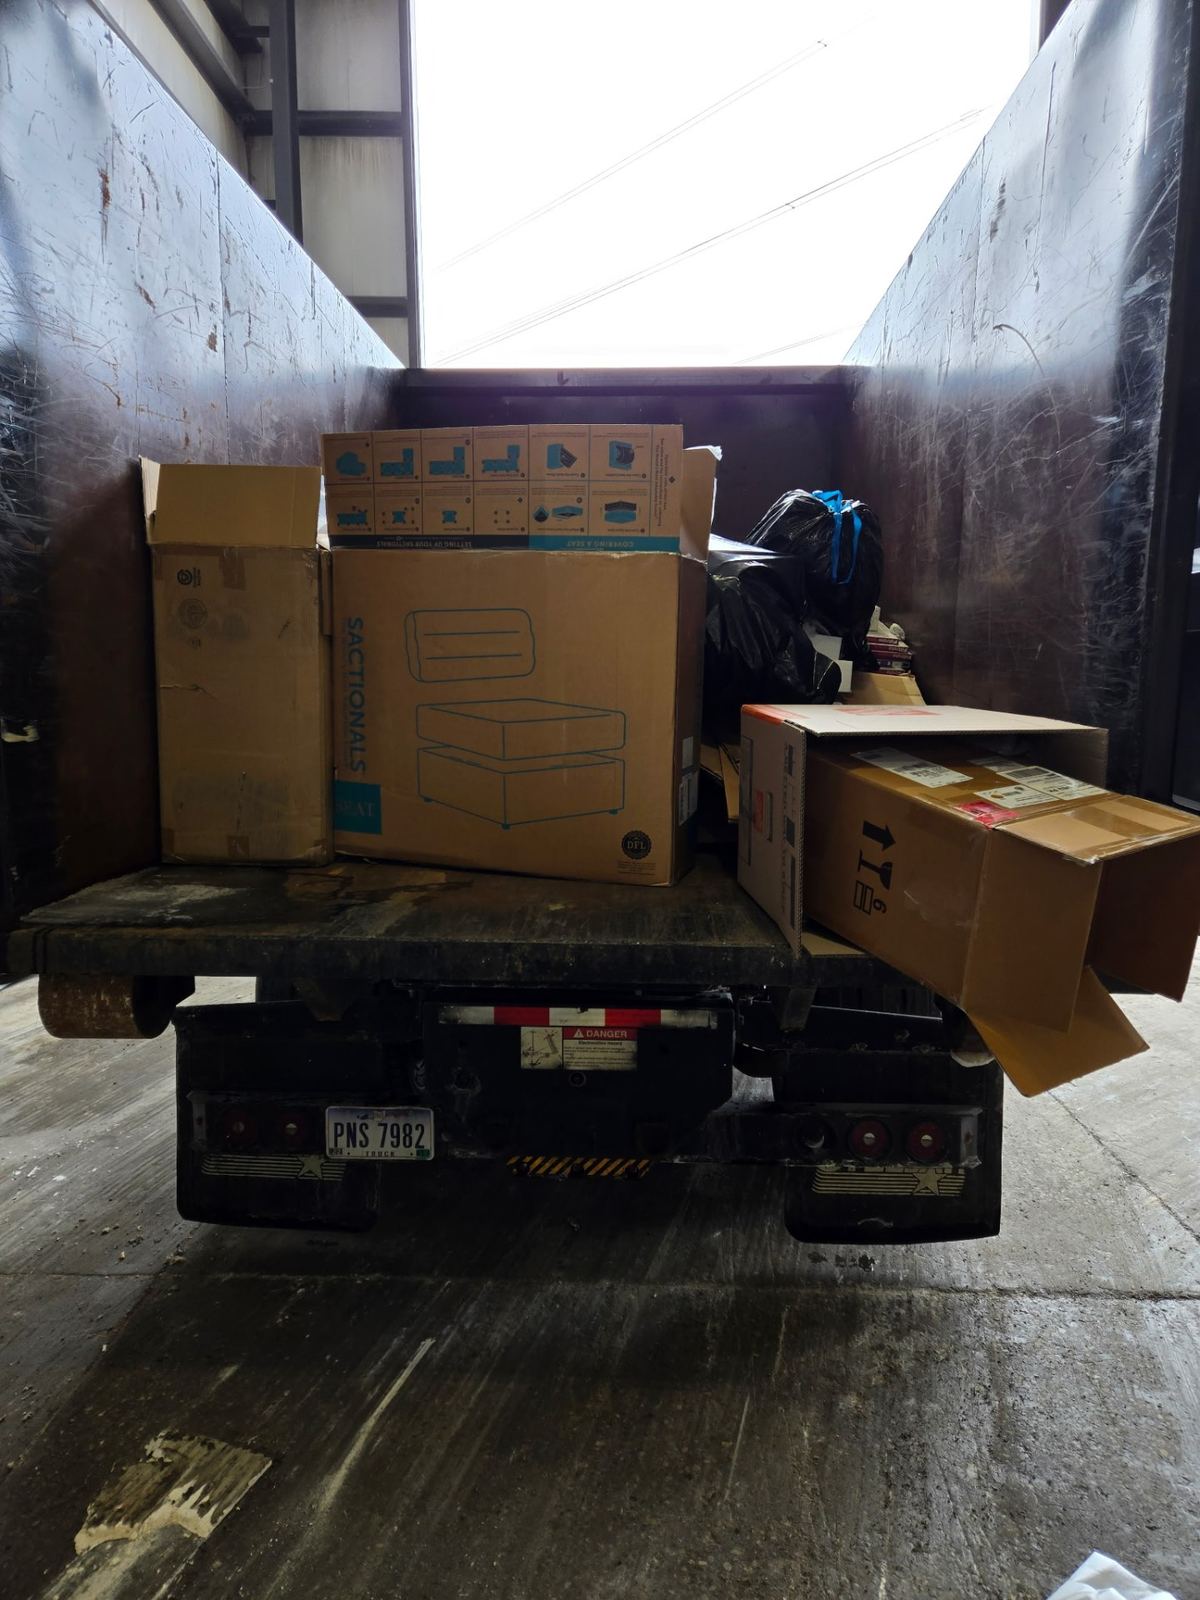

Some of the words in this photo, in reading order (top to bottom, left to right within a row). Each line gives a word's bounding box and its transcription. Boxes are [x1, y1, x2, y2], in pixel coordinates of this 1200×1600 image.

[348, 617, 366, 773] SACTIONALS
[627, 840, 647, 850] DFL
[586, 1029, 628, 1039] DANGER
[334, 1122, 369, 1148] PNS
[377, 1123, 425, 1149] 7982
